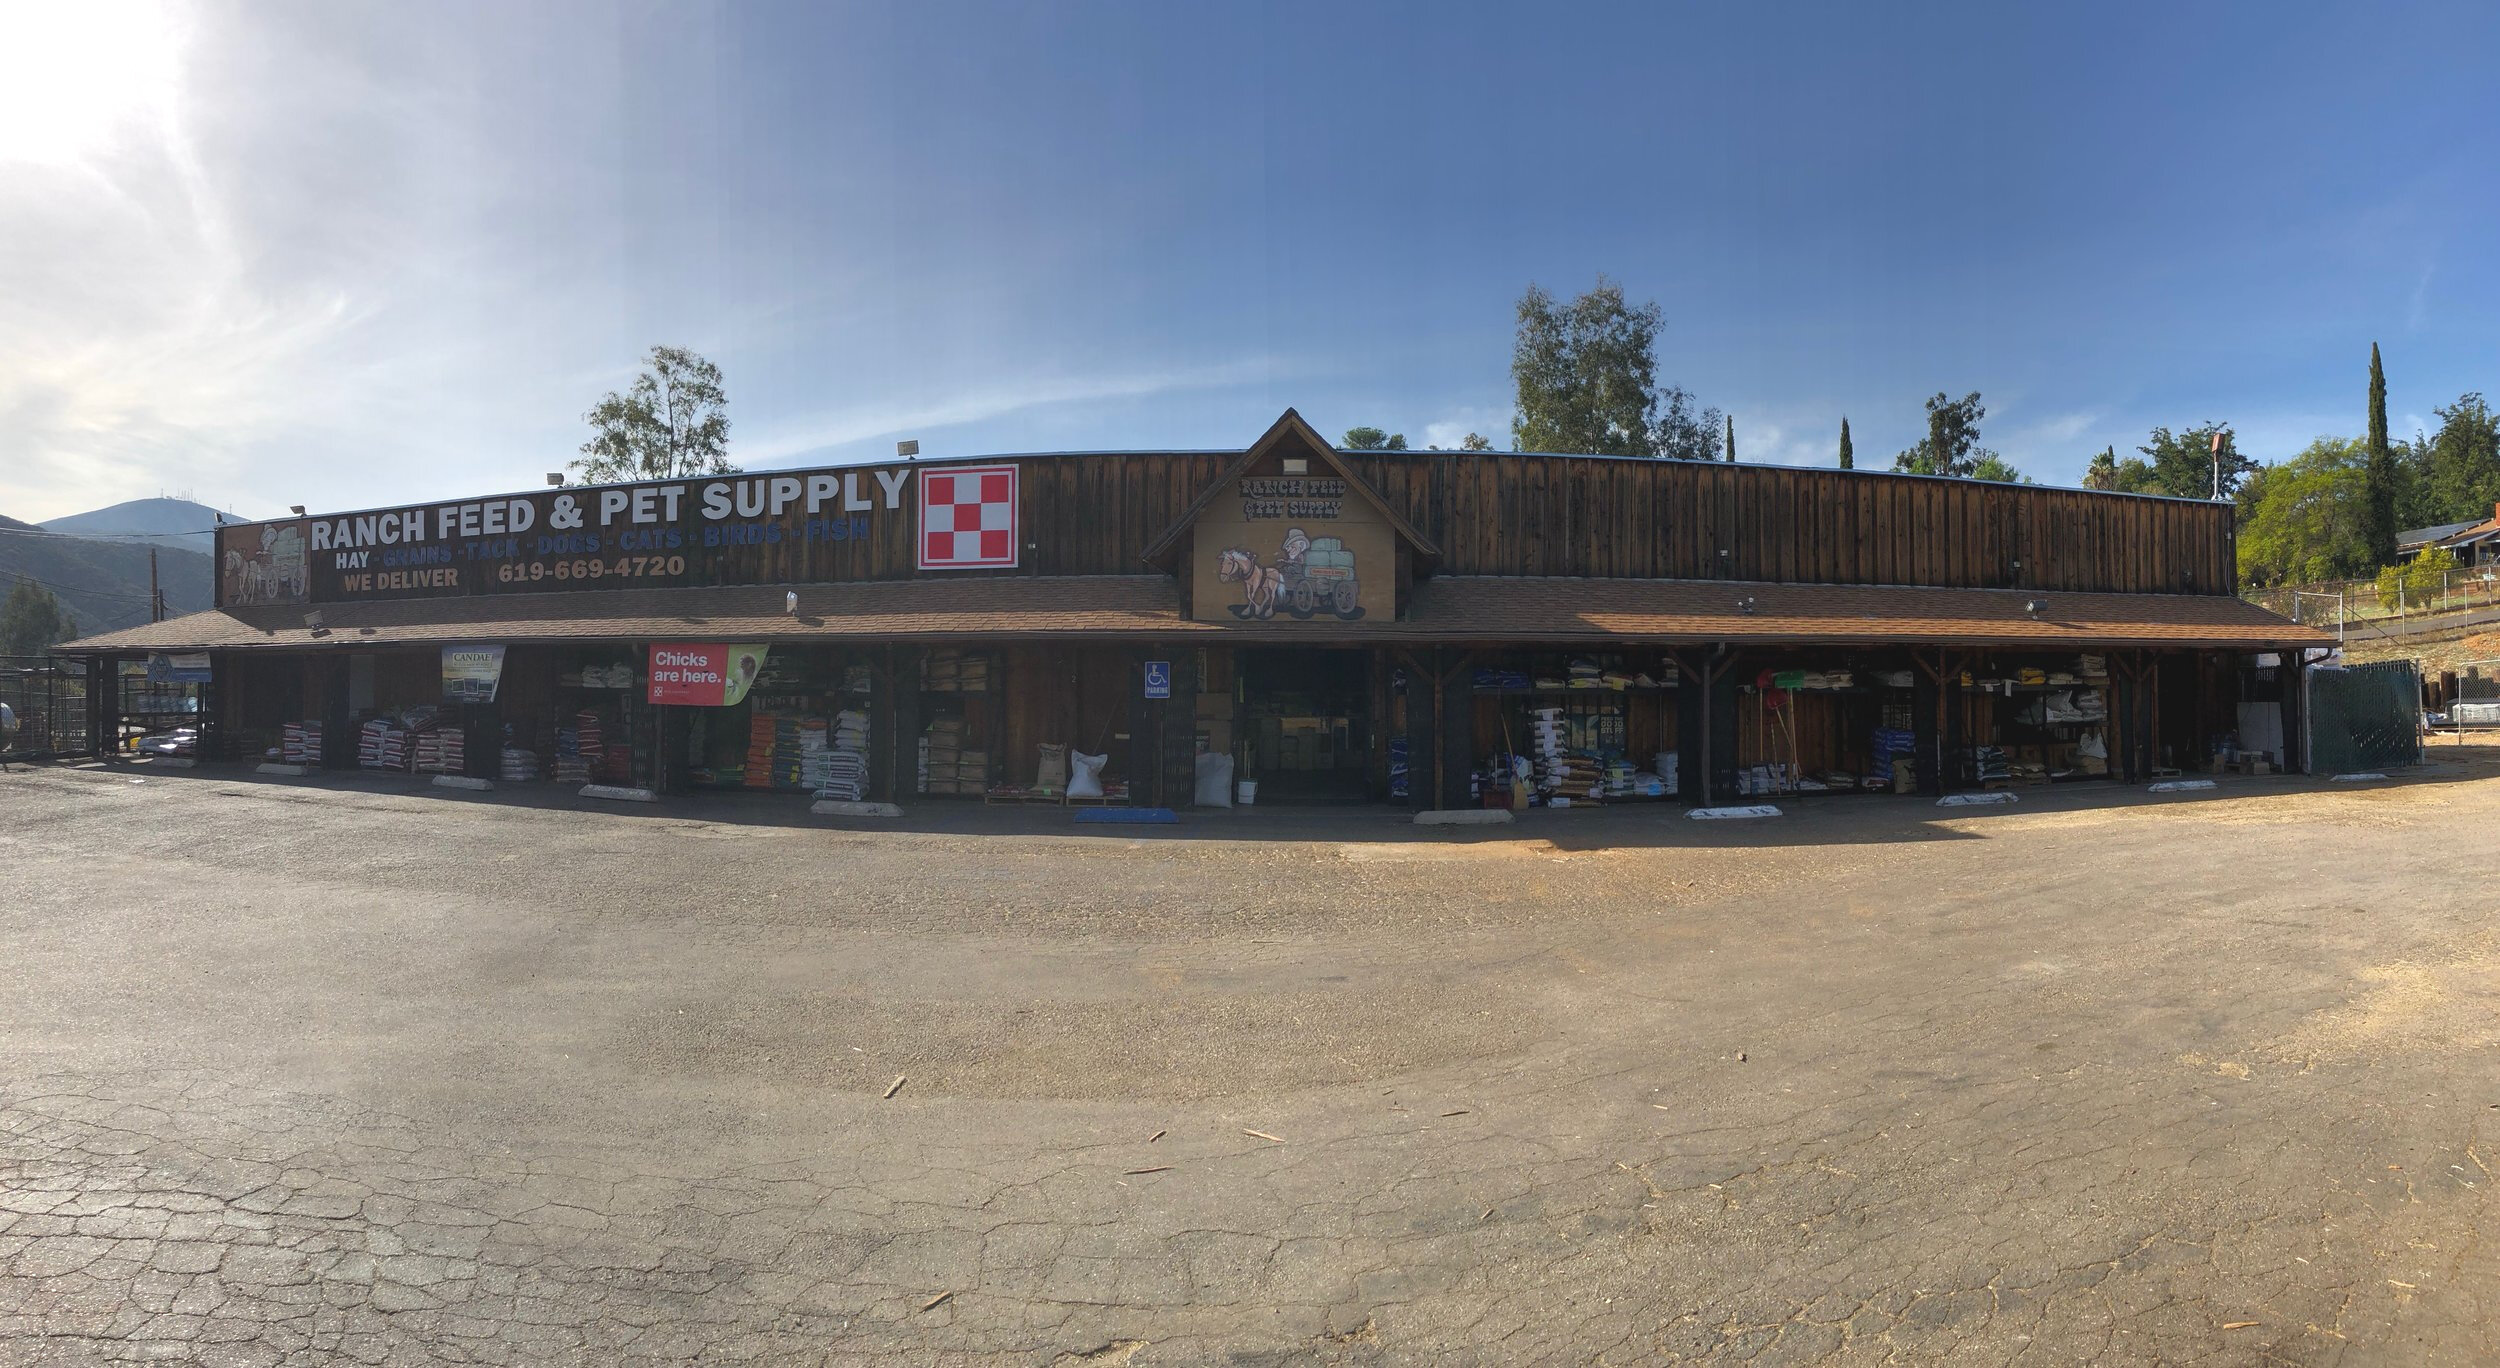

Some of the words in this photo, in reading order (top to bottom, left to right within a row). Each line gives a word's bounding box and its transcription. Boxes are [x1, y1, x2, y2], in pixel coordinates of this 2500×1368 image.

[1240, 479, 1305, 499] RANCH
[1308, 479, 1347, 498] FEED
[311, 510, 425, 551] RANCH
[438, 499, 536, 539] FEED
[549, 494, 584, 530] &
[600, 485, 686, 526] PET
[701, 469, 911, 520] SUPPLY
[1288, 501, 1342, 518] SUPPLY
[336, 551, 370, 570] HAY
[383, 545, 452, 567] GRAINS
[465, 537, 520, 561] TACK
[537, 532, 601, 556] DOGS
[620, 527, 682, 551] CATS
[704, 522, 783, 547] BIRDS
[807, 516, 871, 545] FISH
[344, 573, 372, 592] WE
[377, 567, 458, 590] DELIVER
[498, 555, 685, 583] 619-669-4720
[655, 651, 708, 667] Chicks
[654, 670, 680, 683] are
[681, 668, 722, 683] here.
[1147, 686, 1168, 694] PARKING
